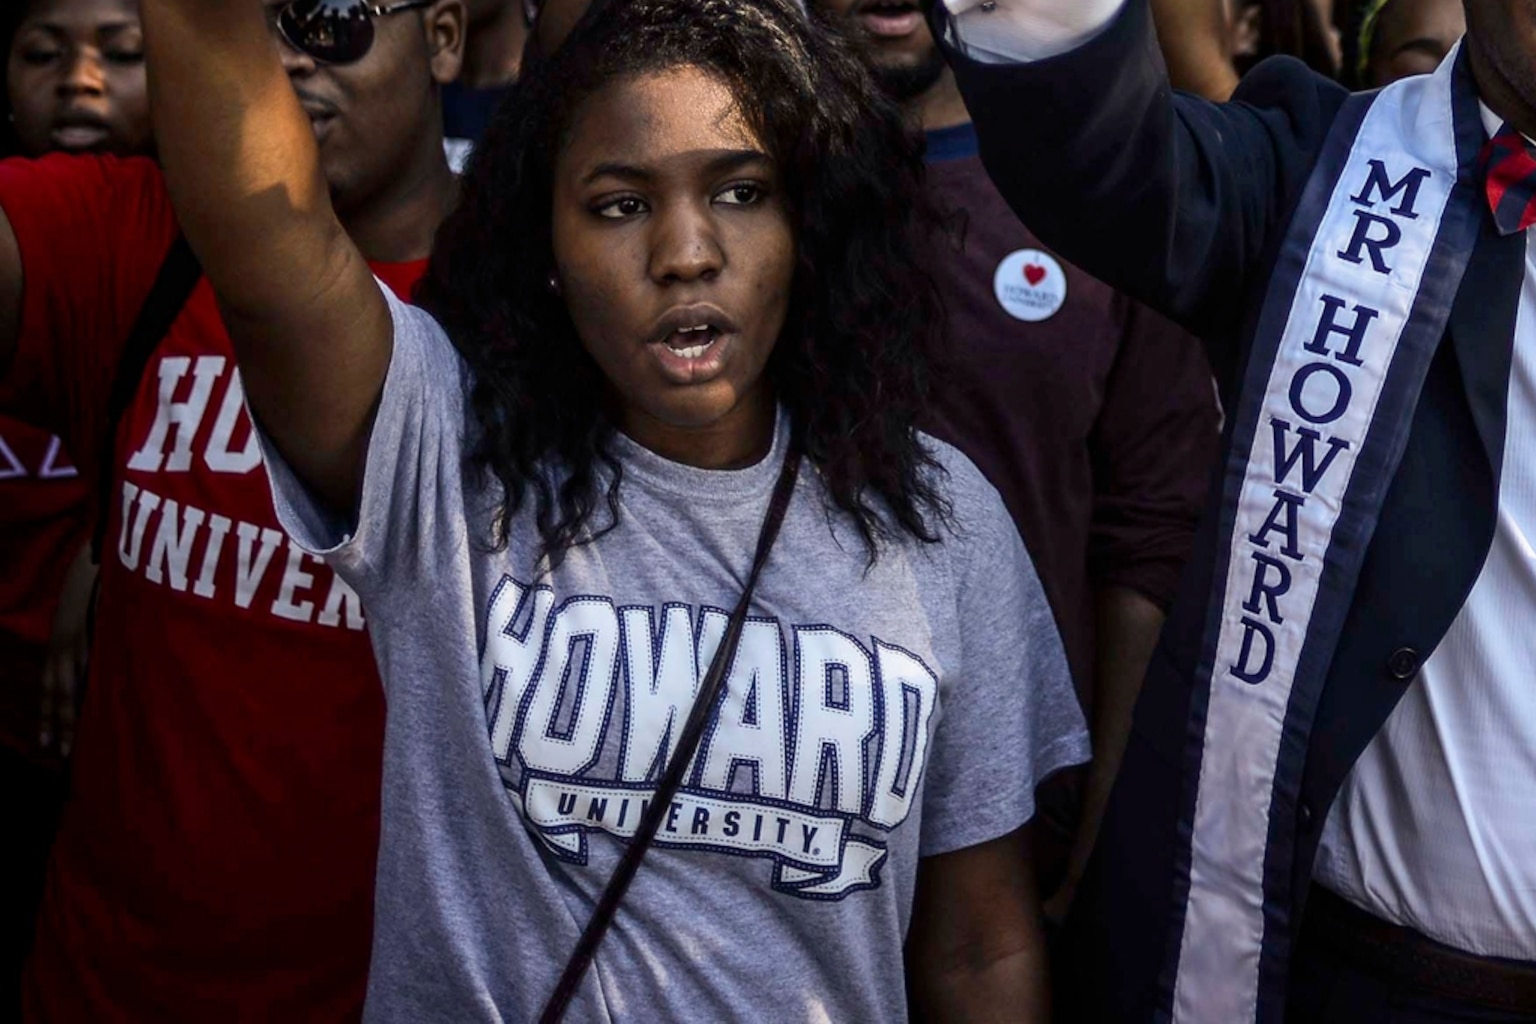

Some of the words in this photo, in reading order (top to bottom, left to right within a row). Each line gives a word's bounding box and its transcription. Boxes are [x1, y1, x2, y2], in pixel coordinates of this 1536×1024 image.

[1337, 158, 1432, 275] MR
[1229, 293, 1380, 686] HOWARD
[480, 573, 938, 832] HOWARD
[557, 792, 819, 854] UNIERSITY
